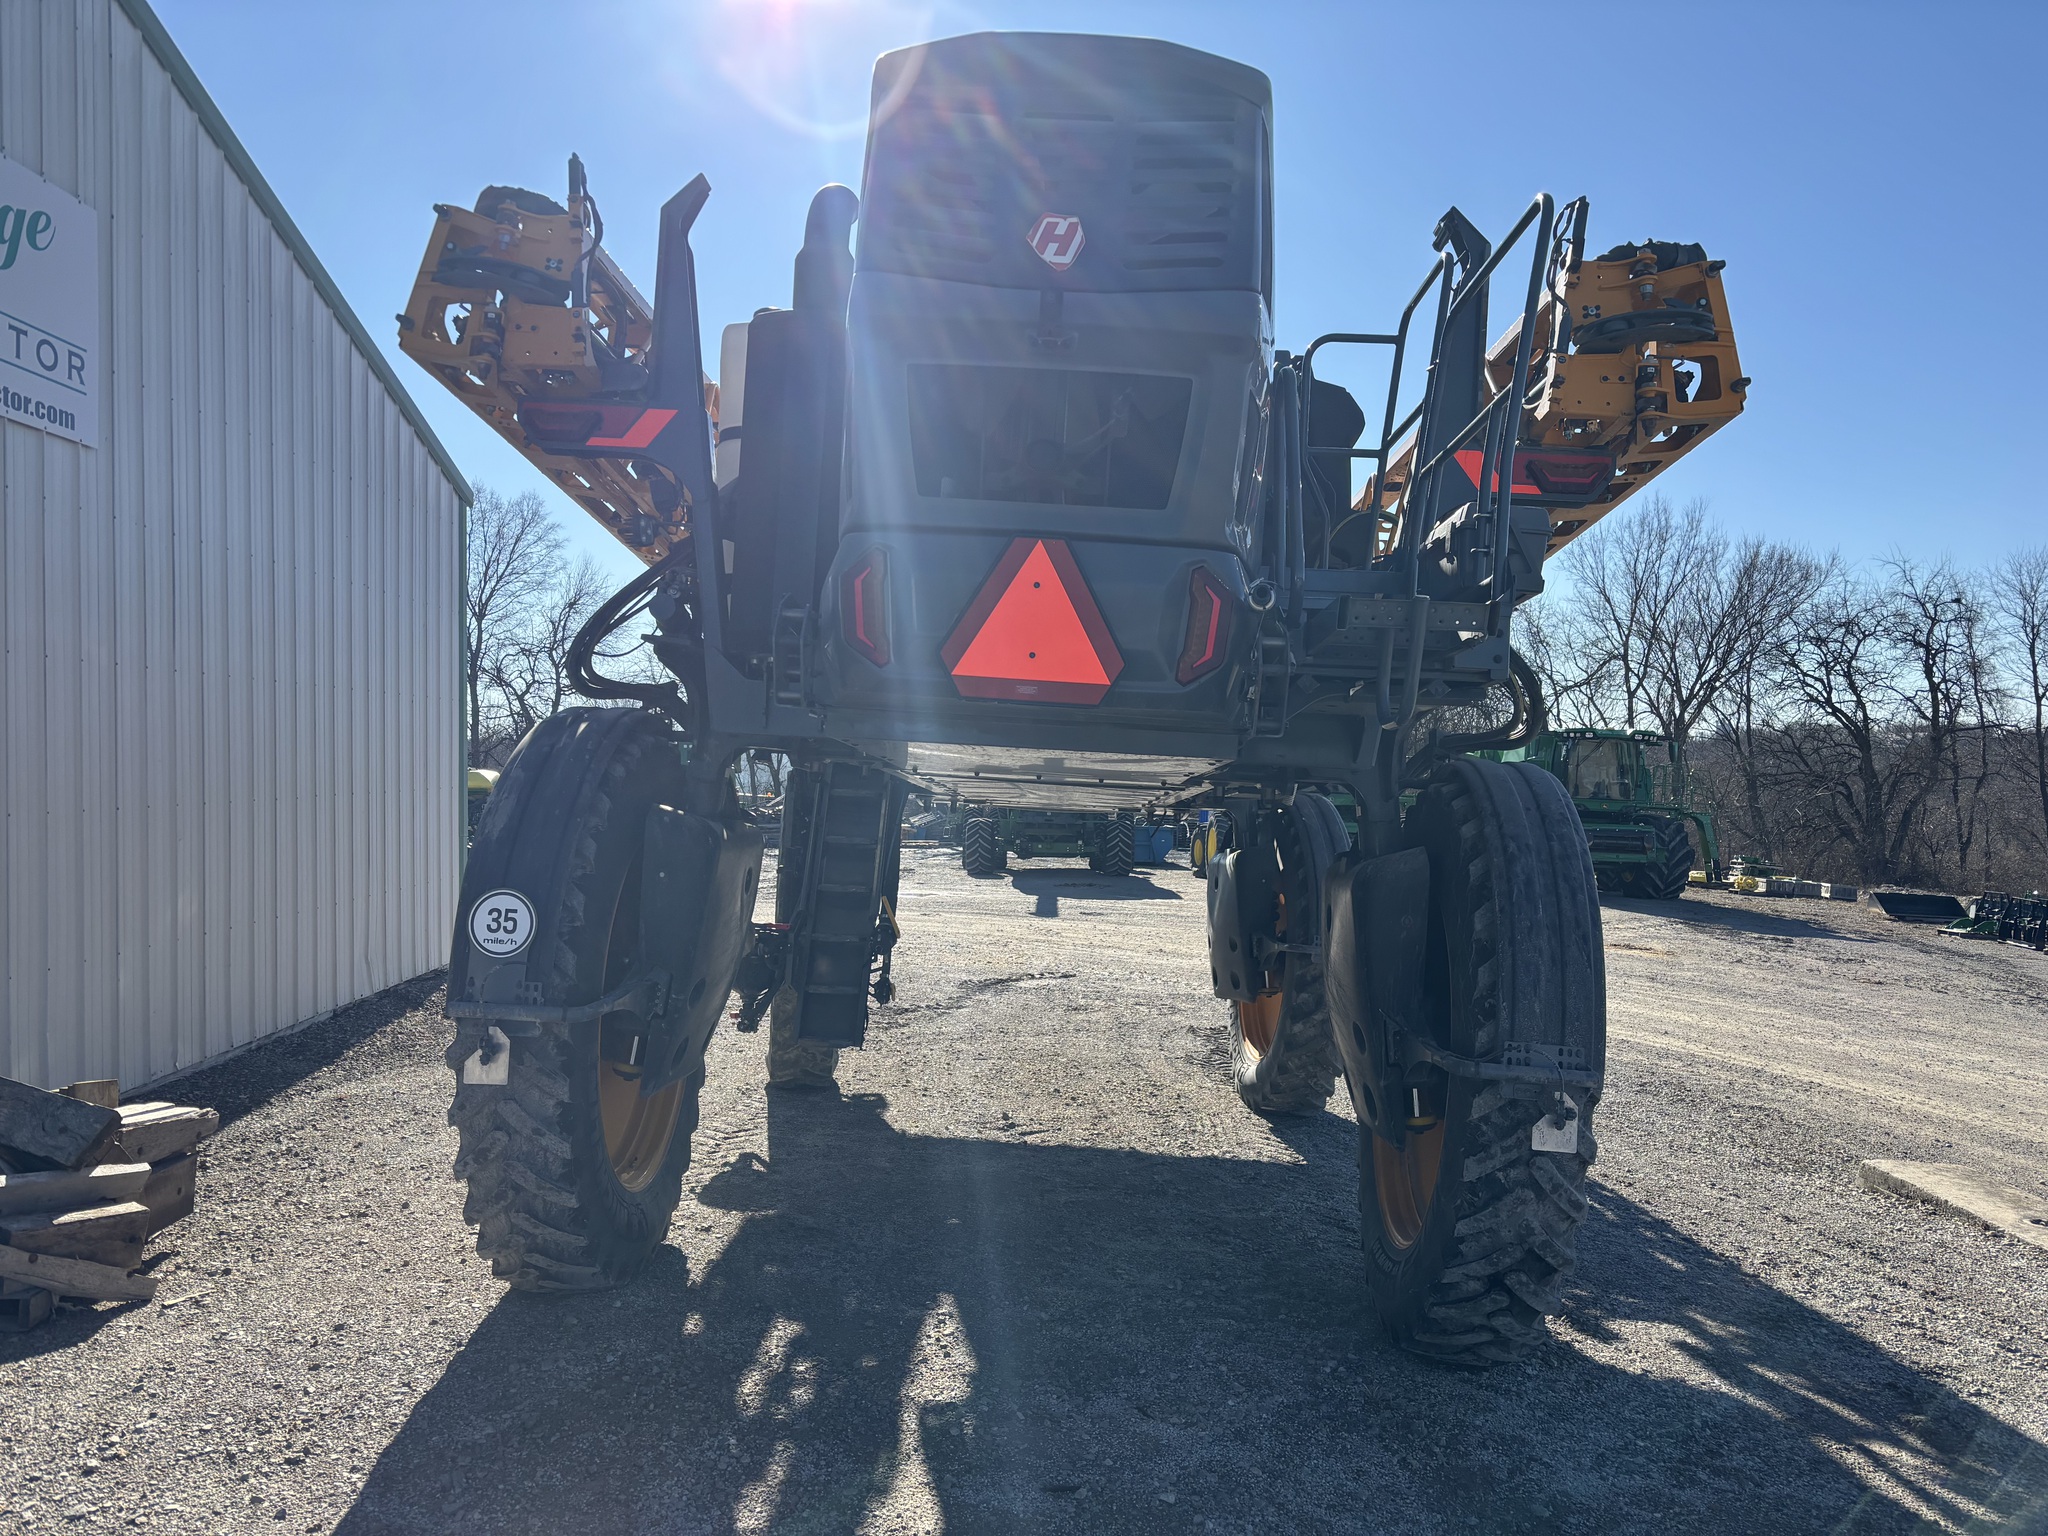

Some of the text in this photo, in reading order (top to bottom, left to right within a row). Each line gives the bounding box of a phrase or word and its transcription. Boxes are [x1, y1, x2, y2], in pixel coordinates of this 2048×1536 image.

[1033, 217, 1082, 262] H
[8, 322, 86, 386] TOR
[0, 386, 75, 431] tor.com
[483, 937, 517, 945] mile/h
[486, 907, 518, 934] 35
